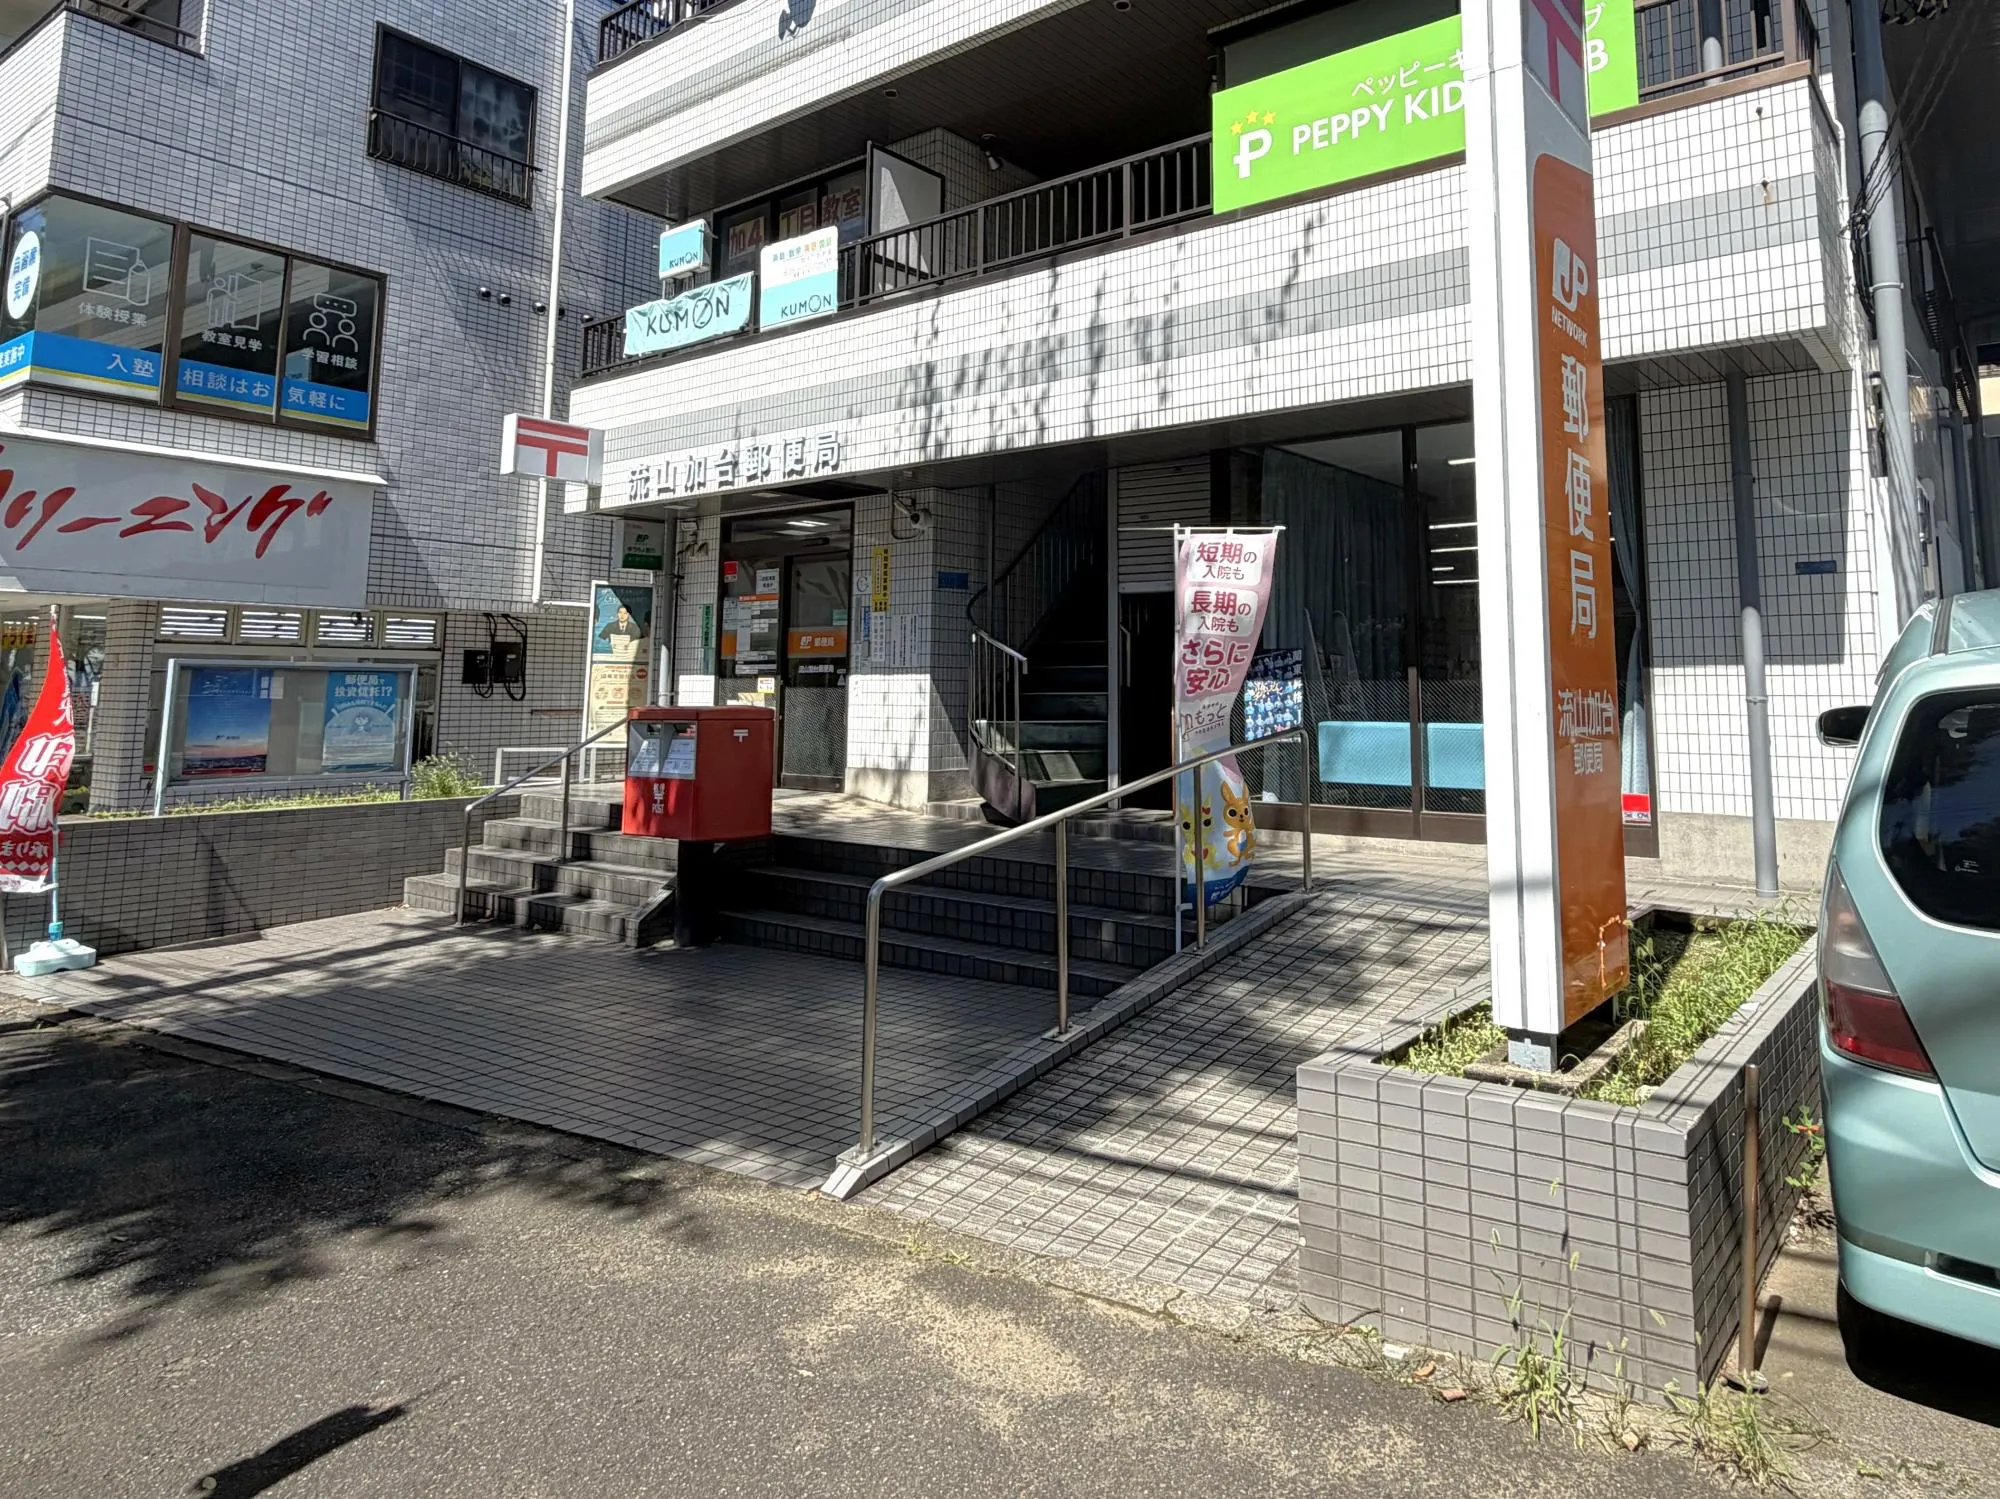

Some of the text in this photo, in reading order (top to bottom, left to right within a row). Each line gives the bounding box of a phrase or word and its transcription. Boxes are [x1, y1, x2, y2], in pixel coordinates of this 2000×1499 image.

[1292, 99, 1395, 156] PEPPY
[669, 252, 698, 269] KUMON
[79, 302, 148, 327] 体験授業
[646, 294, 730, 337] KUMON
[780, 293, 832, 319] KUMON
[1552, 304, 1588, 349] NETWORK
[201, 329, 263, 352] 教室見学
[300, 346, 359, 371] 学習相談
[629, 431, 842, 501] 流山加台郵便局
[1561, 353, 1597, 640] 郵便局
[1196, 542, 1257, 565] 短期の
[1202, 565, 1245, 581] 入院も
[1191, 591, 1251, 617] 長期の
[1198, 616, 1239, 633] 入院も
[1182, 639, 1249, 665] さらに
[1186, 667, 1230, 695] 安心
[1557, 688, 1615, 736] 流山加台
[1573, 741, 1603, 777] 郵便局
